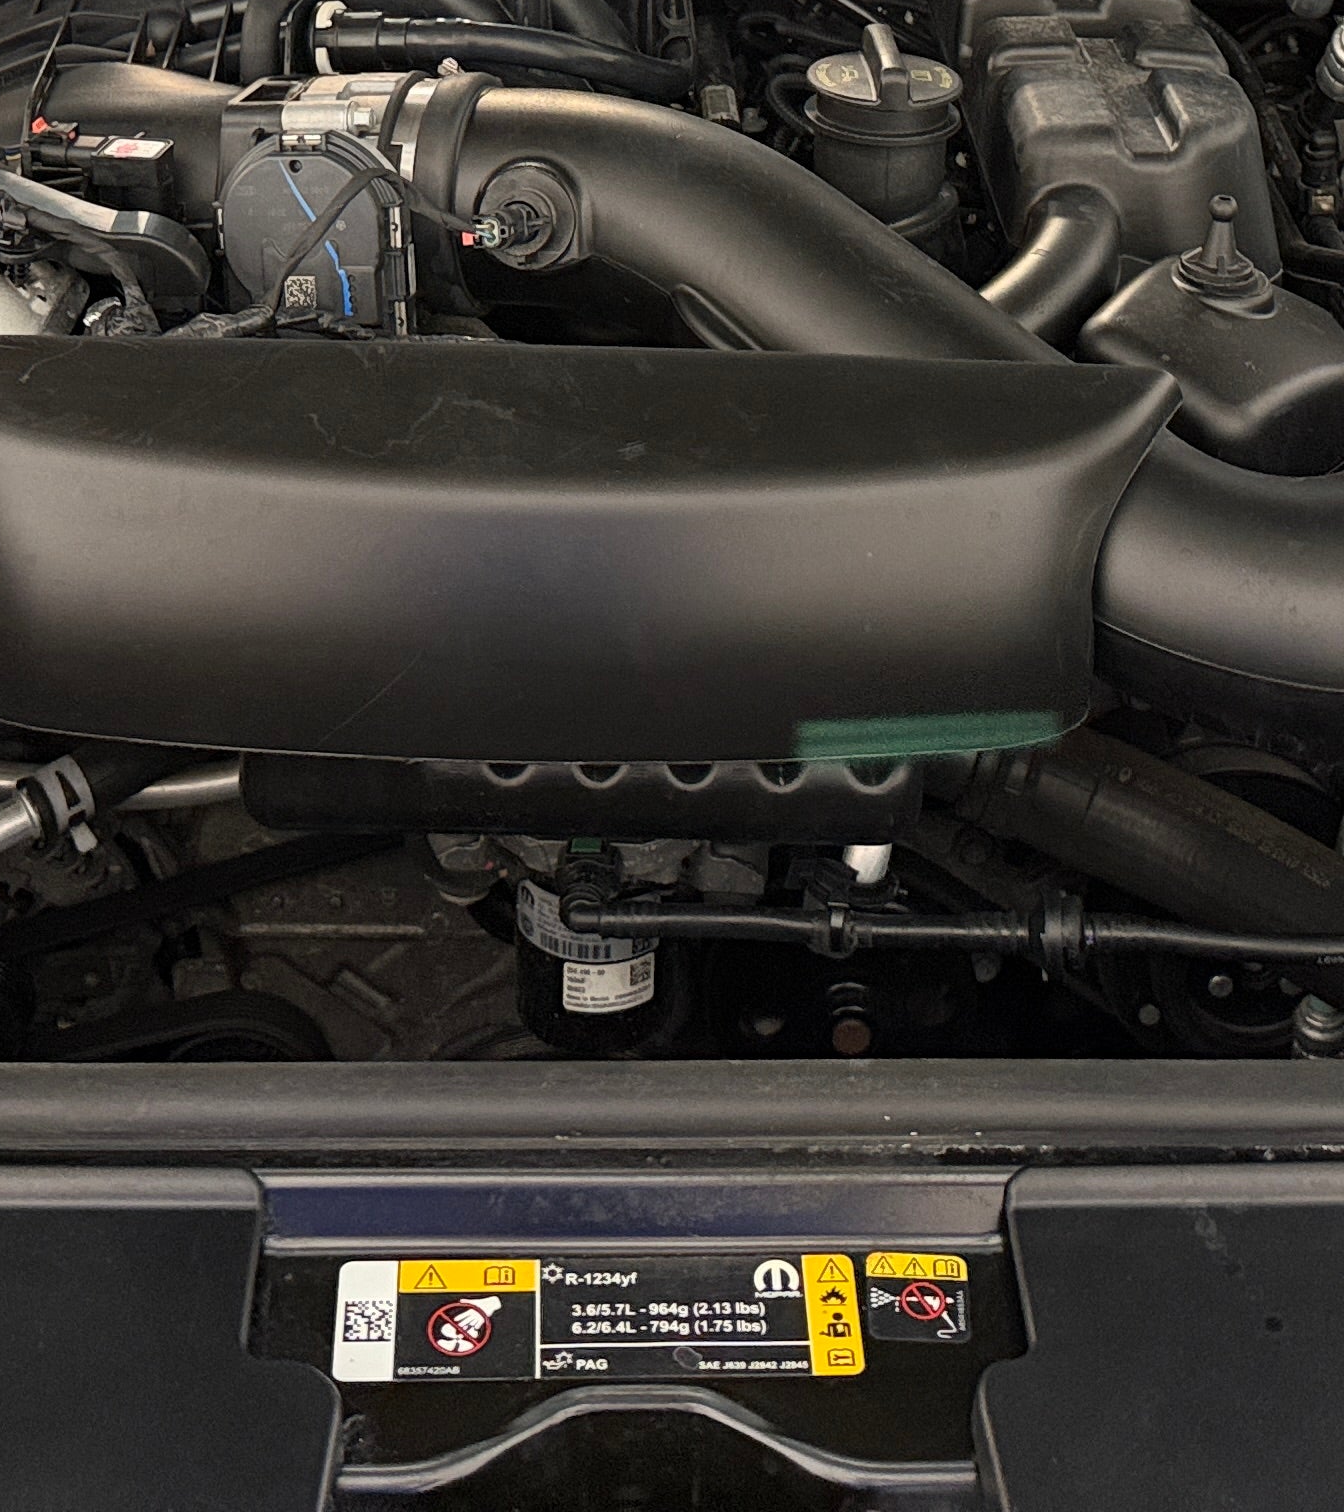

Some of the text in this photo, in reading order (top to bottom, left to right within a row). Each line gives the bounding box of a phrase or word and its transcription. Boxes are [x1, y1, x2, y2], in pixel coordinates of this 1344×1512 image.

[565, 1272, 638, 1288] R-1234yf
[571, 1303, 636, 1317] 3.6/5.7L
[649, 1303, 689, 1318] 964g
[693, 1302, 732, 1317] (2.13
[735, 1301, 766, 1316] lbs)
[571, 1321, 637, 1335] 6.2/6.4L
[650, 1320, 690, 1335] 794g
[694, 1320, 733, 1334] (1.75
[737, 1319, 767, 1334] lbs)
[575, 1359, 608, 1370] PAG
